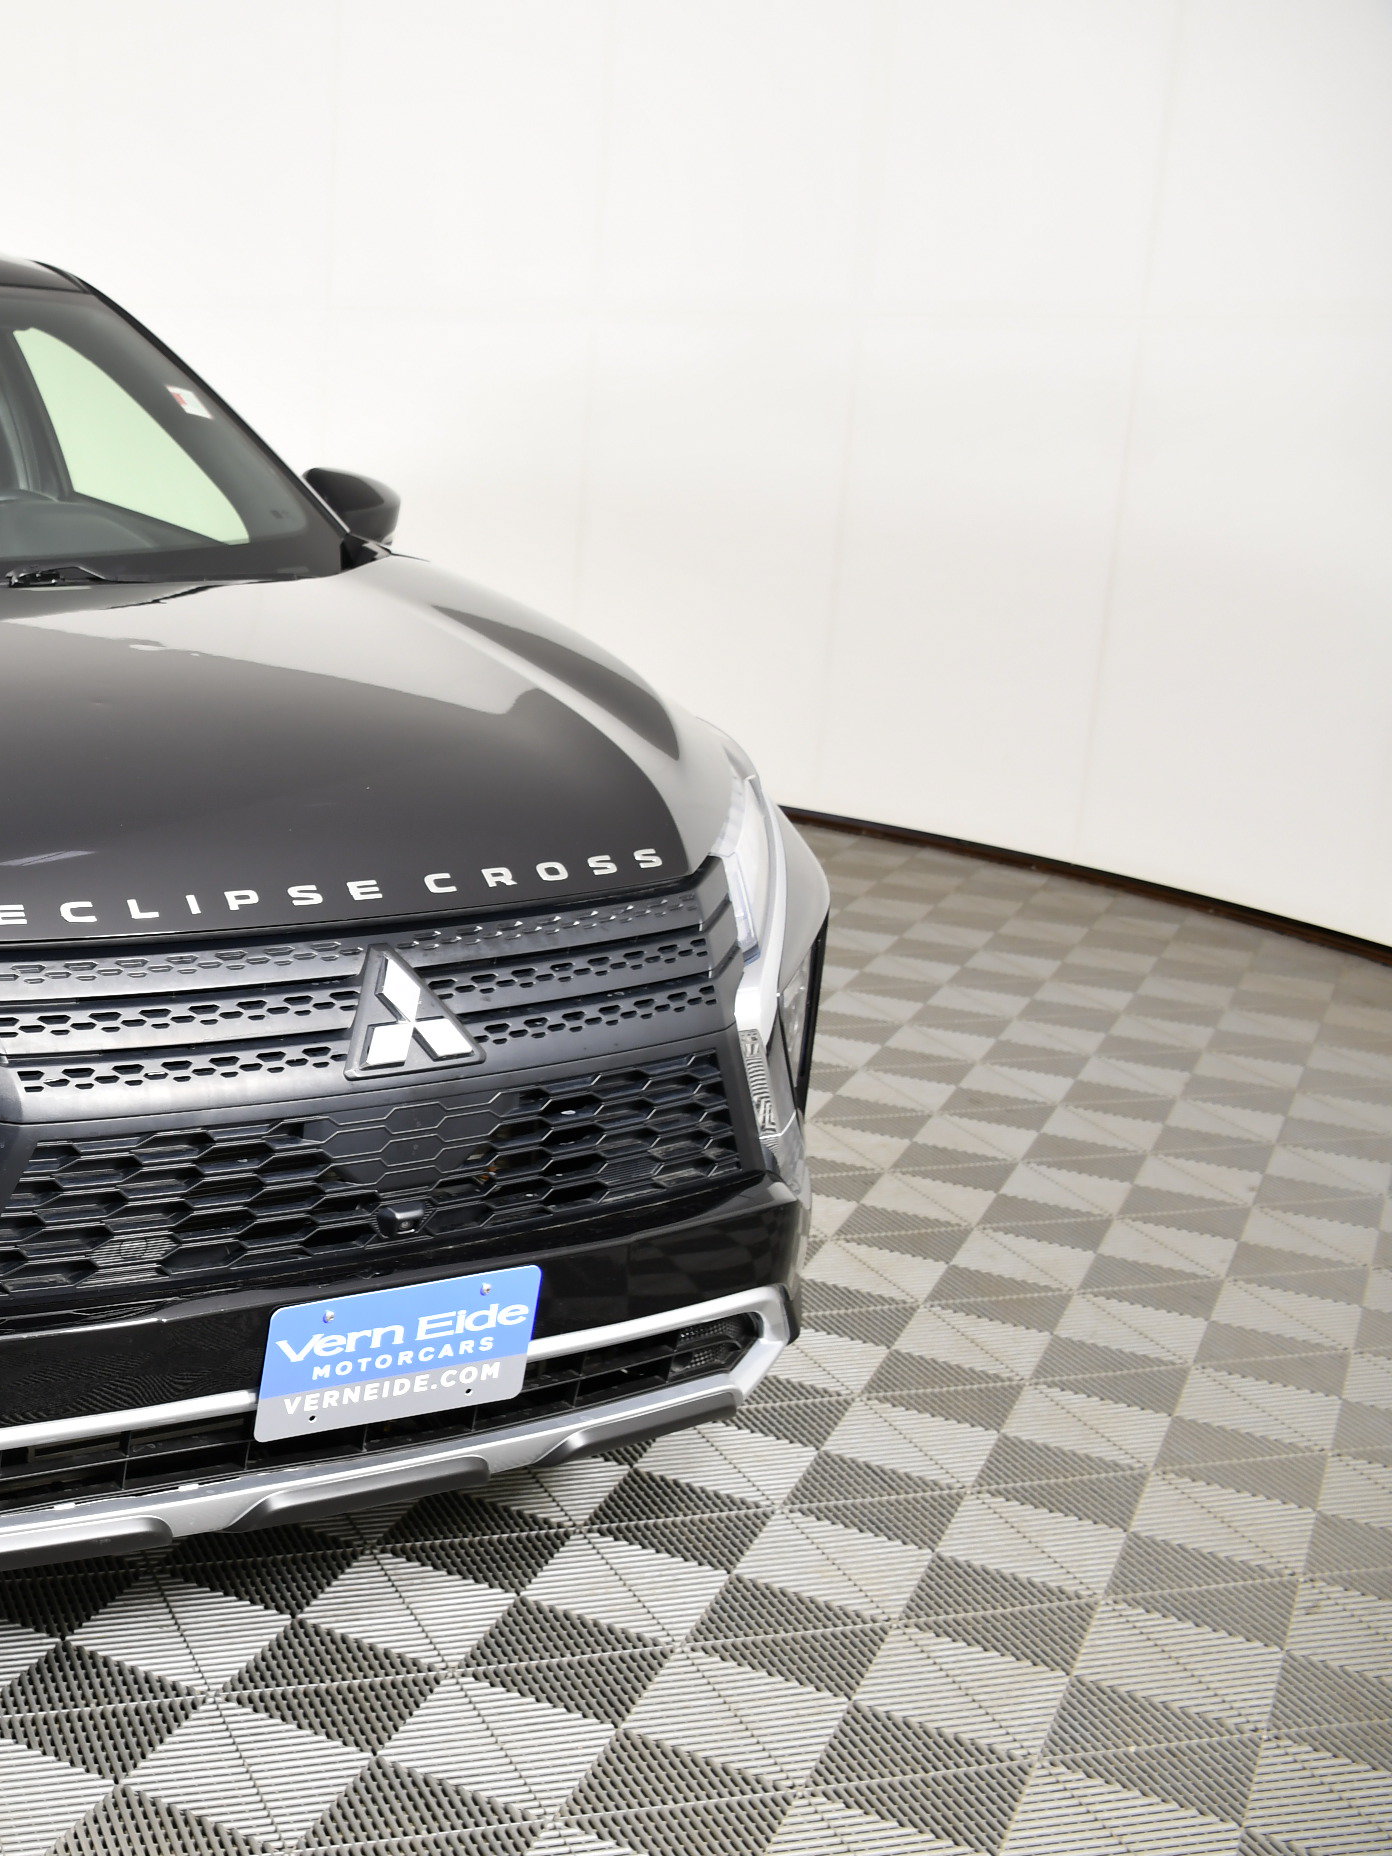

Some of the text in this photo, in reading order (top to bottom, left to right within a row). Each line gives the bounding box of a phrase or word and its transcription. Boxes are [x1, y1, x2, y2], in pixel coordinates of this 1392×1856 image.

[423, 848, 663, 894] CROSS
[275, 1303, 529, 1363] Vern Eide
[311, 1336, 494, 1380] MOTORCARS
[283, 1361, 501, 1415] VERNEIDE.COM
